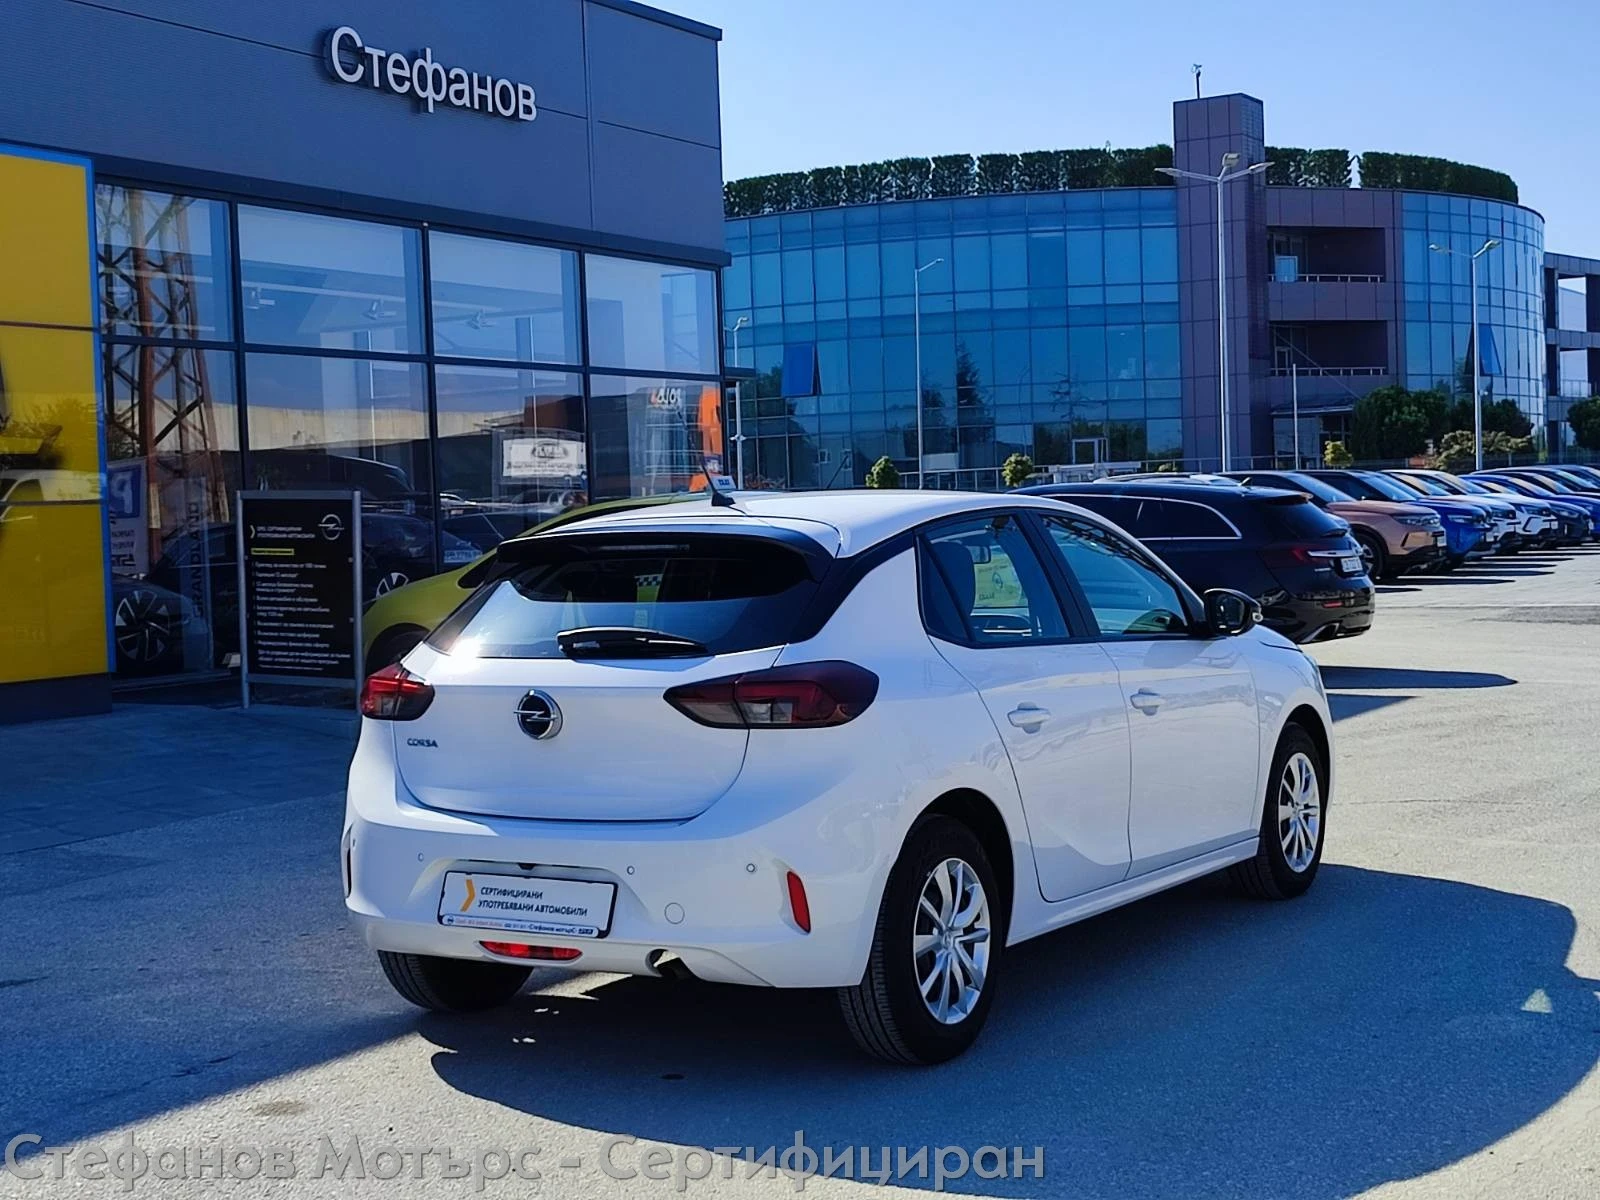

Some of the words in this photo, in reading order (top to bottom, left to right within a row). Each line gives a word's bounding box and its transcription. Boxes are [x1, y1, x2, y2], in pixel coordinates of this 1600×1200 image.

[331, 26, 538, 121] Стефанов
[407, 738, 438, 748] CORSA
[480, 887, 543, 899] СЕРТИФИЦИРАНИ
[478, 900, 534, 912] УПОТРЕБЯВАНИ
[535, 904, 588, 916] АВТОМОБИЛИ
